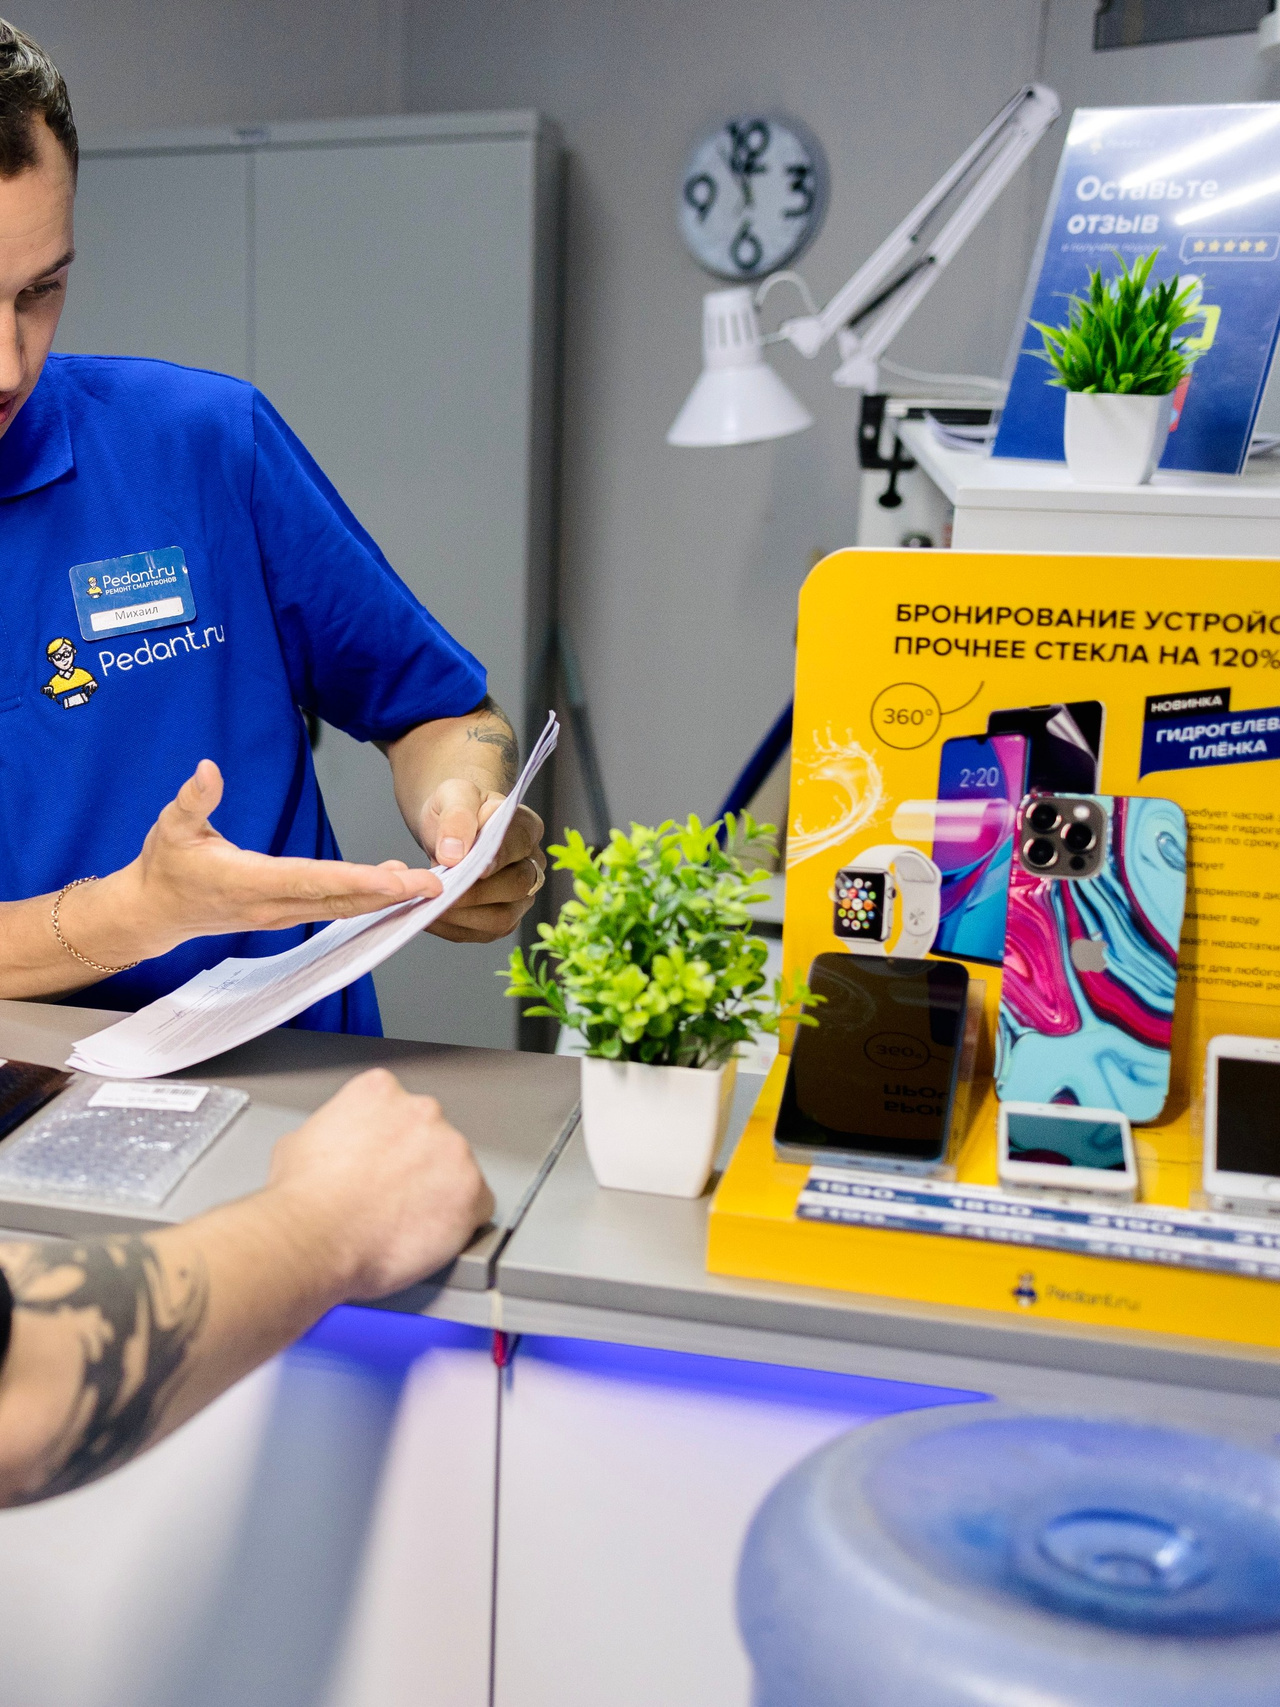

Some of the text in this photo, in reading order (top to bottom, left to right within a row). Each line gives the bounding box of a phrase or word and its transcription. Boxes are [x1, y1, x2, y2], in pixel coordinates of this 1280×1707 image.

[683, 164, 815, 224] 9 3
[1076, 175, 1219, 201] Оставьте
[1066, 213, 1160, 235] отзыв
[729, 217, 763, 270] 6
[102, 565, 176, 589] Pedant.ru
[105, 576, 177, 596] РЕМОНТ СМАРТФОНОВ
[114, 606, 159, 621] Михаил
[895, 603, 1136, 630] БРОНИРОВАНИЕ
[98, 624, 226, 677] Pedant.ru
[894, 636, 1280, 670] ПРОЧНЕЕ СТЕКЛА НА 120%
[1150, 695, 1223, 713] НОВИНКА
[1155, 717, 1280, 743] ГИДРОГЕЛЕВ
[959, 767, 1000, 788] 2:20
[1184, 808, 1228, 819] ребует
